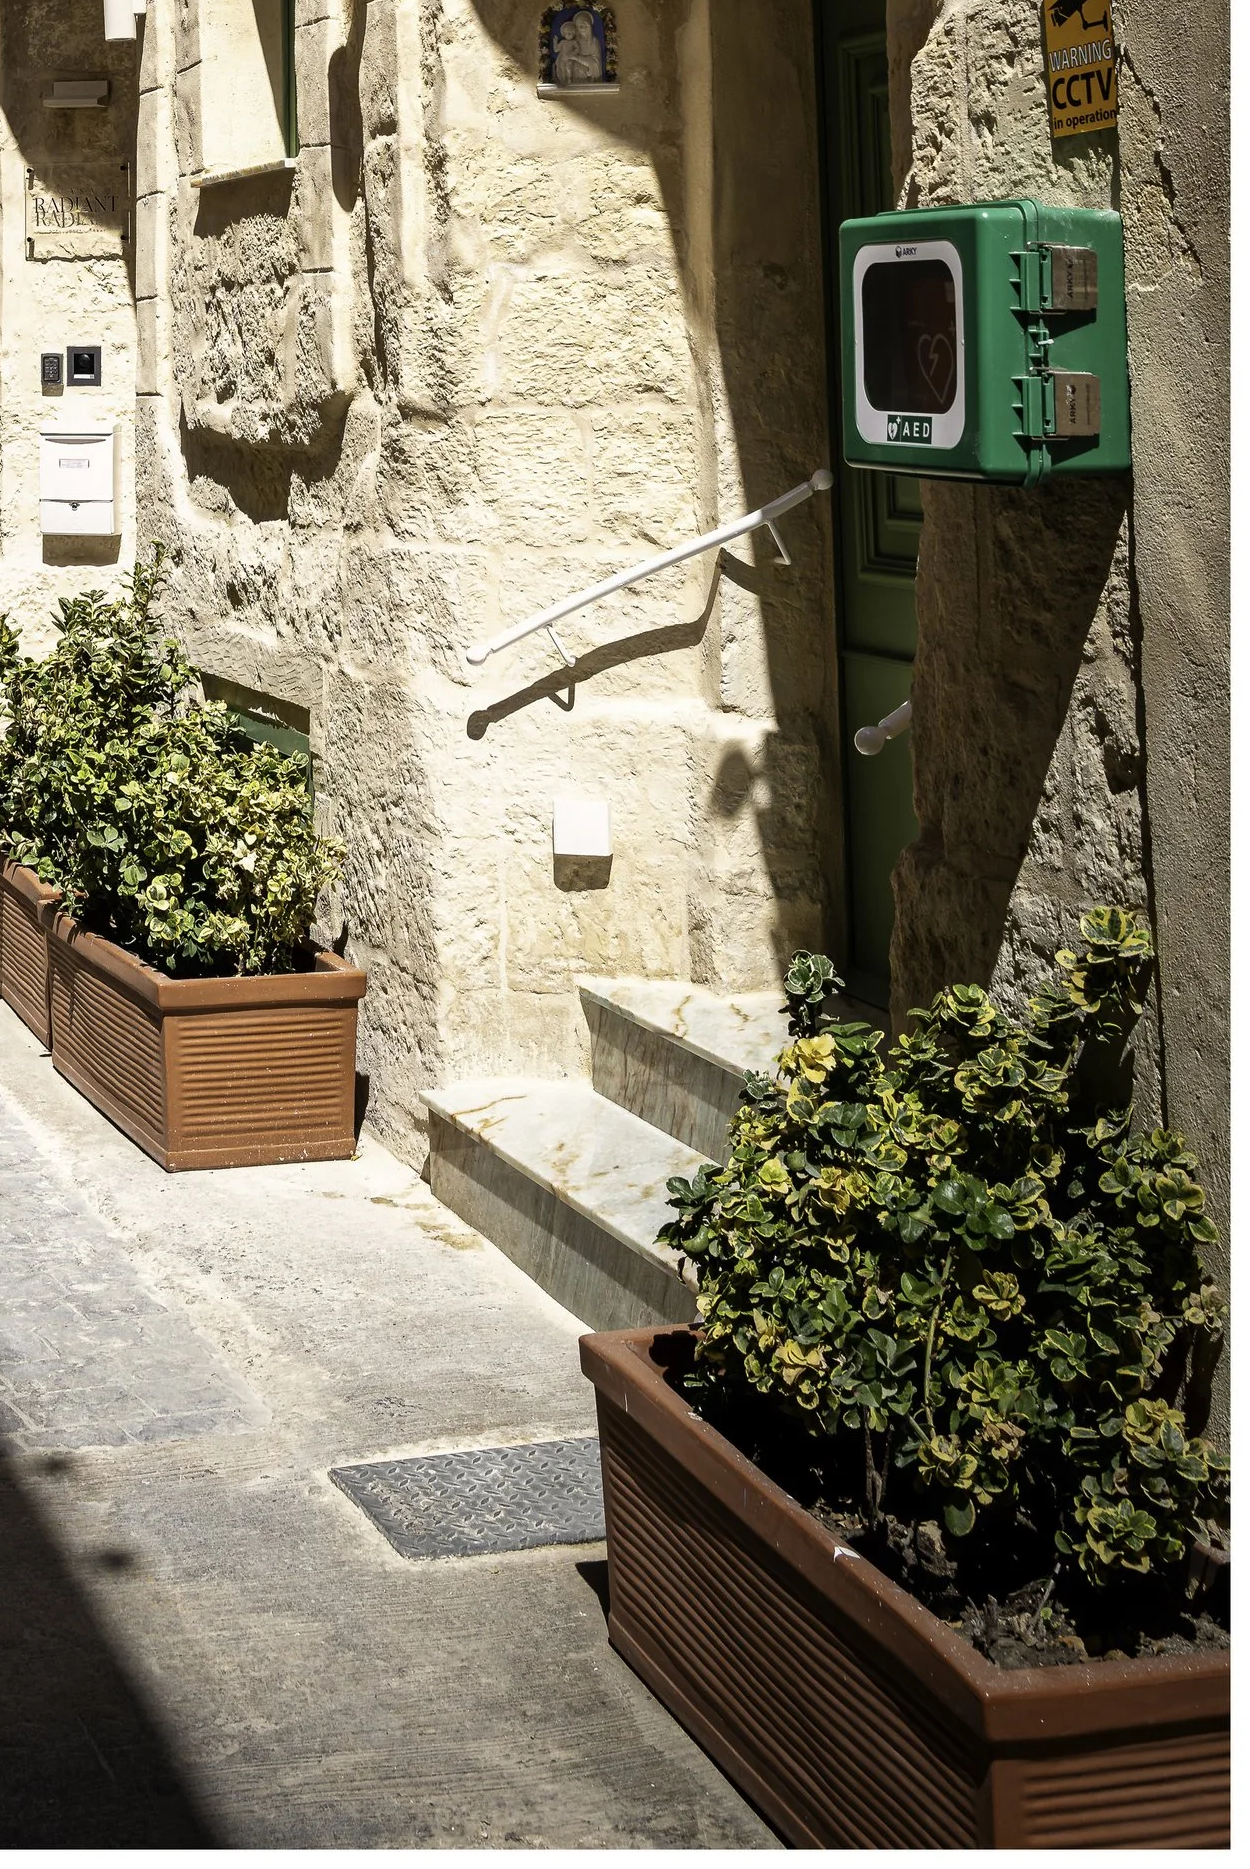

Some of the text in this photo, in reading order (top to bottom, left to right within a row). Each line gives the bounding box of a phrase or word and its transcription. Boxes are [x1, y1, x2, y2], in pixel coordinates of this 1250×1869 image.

[1049, 38, 1112, 72] WARNING
[1052, 67, 1113, 110] CCTV
[1053, 108, 1117, 130] in operation
[34, 196, 119, 212] RADIANT
[902, 247, 917, 256] ARKY
[902, 421, 930, 438] AED
